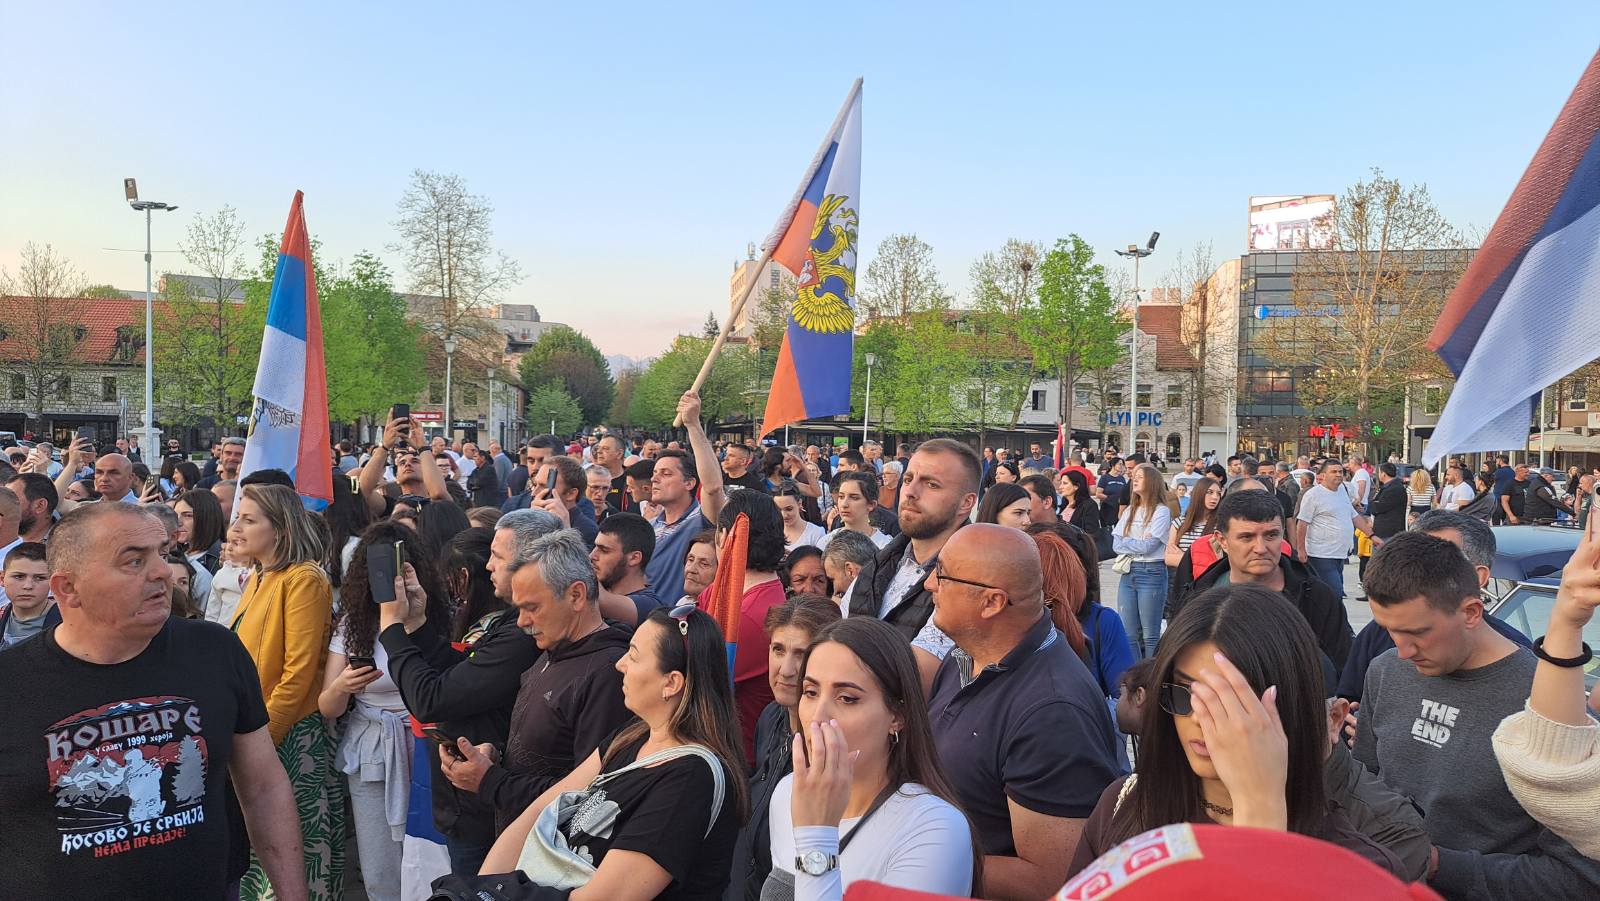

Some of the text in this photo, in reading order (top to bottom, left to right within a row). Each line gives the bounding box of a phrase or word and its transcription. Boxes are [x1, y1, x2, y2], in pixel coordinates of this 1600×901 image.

[1421, 699, 1460, 727] THE
[127, 735, 147, 748] 1999
[1411, 718, 1450, 743] END
